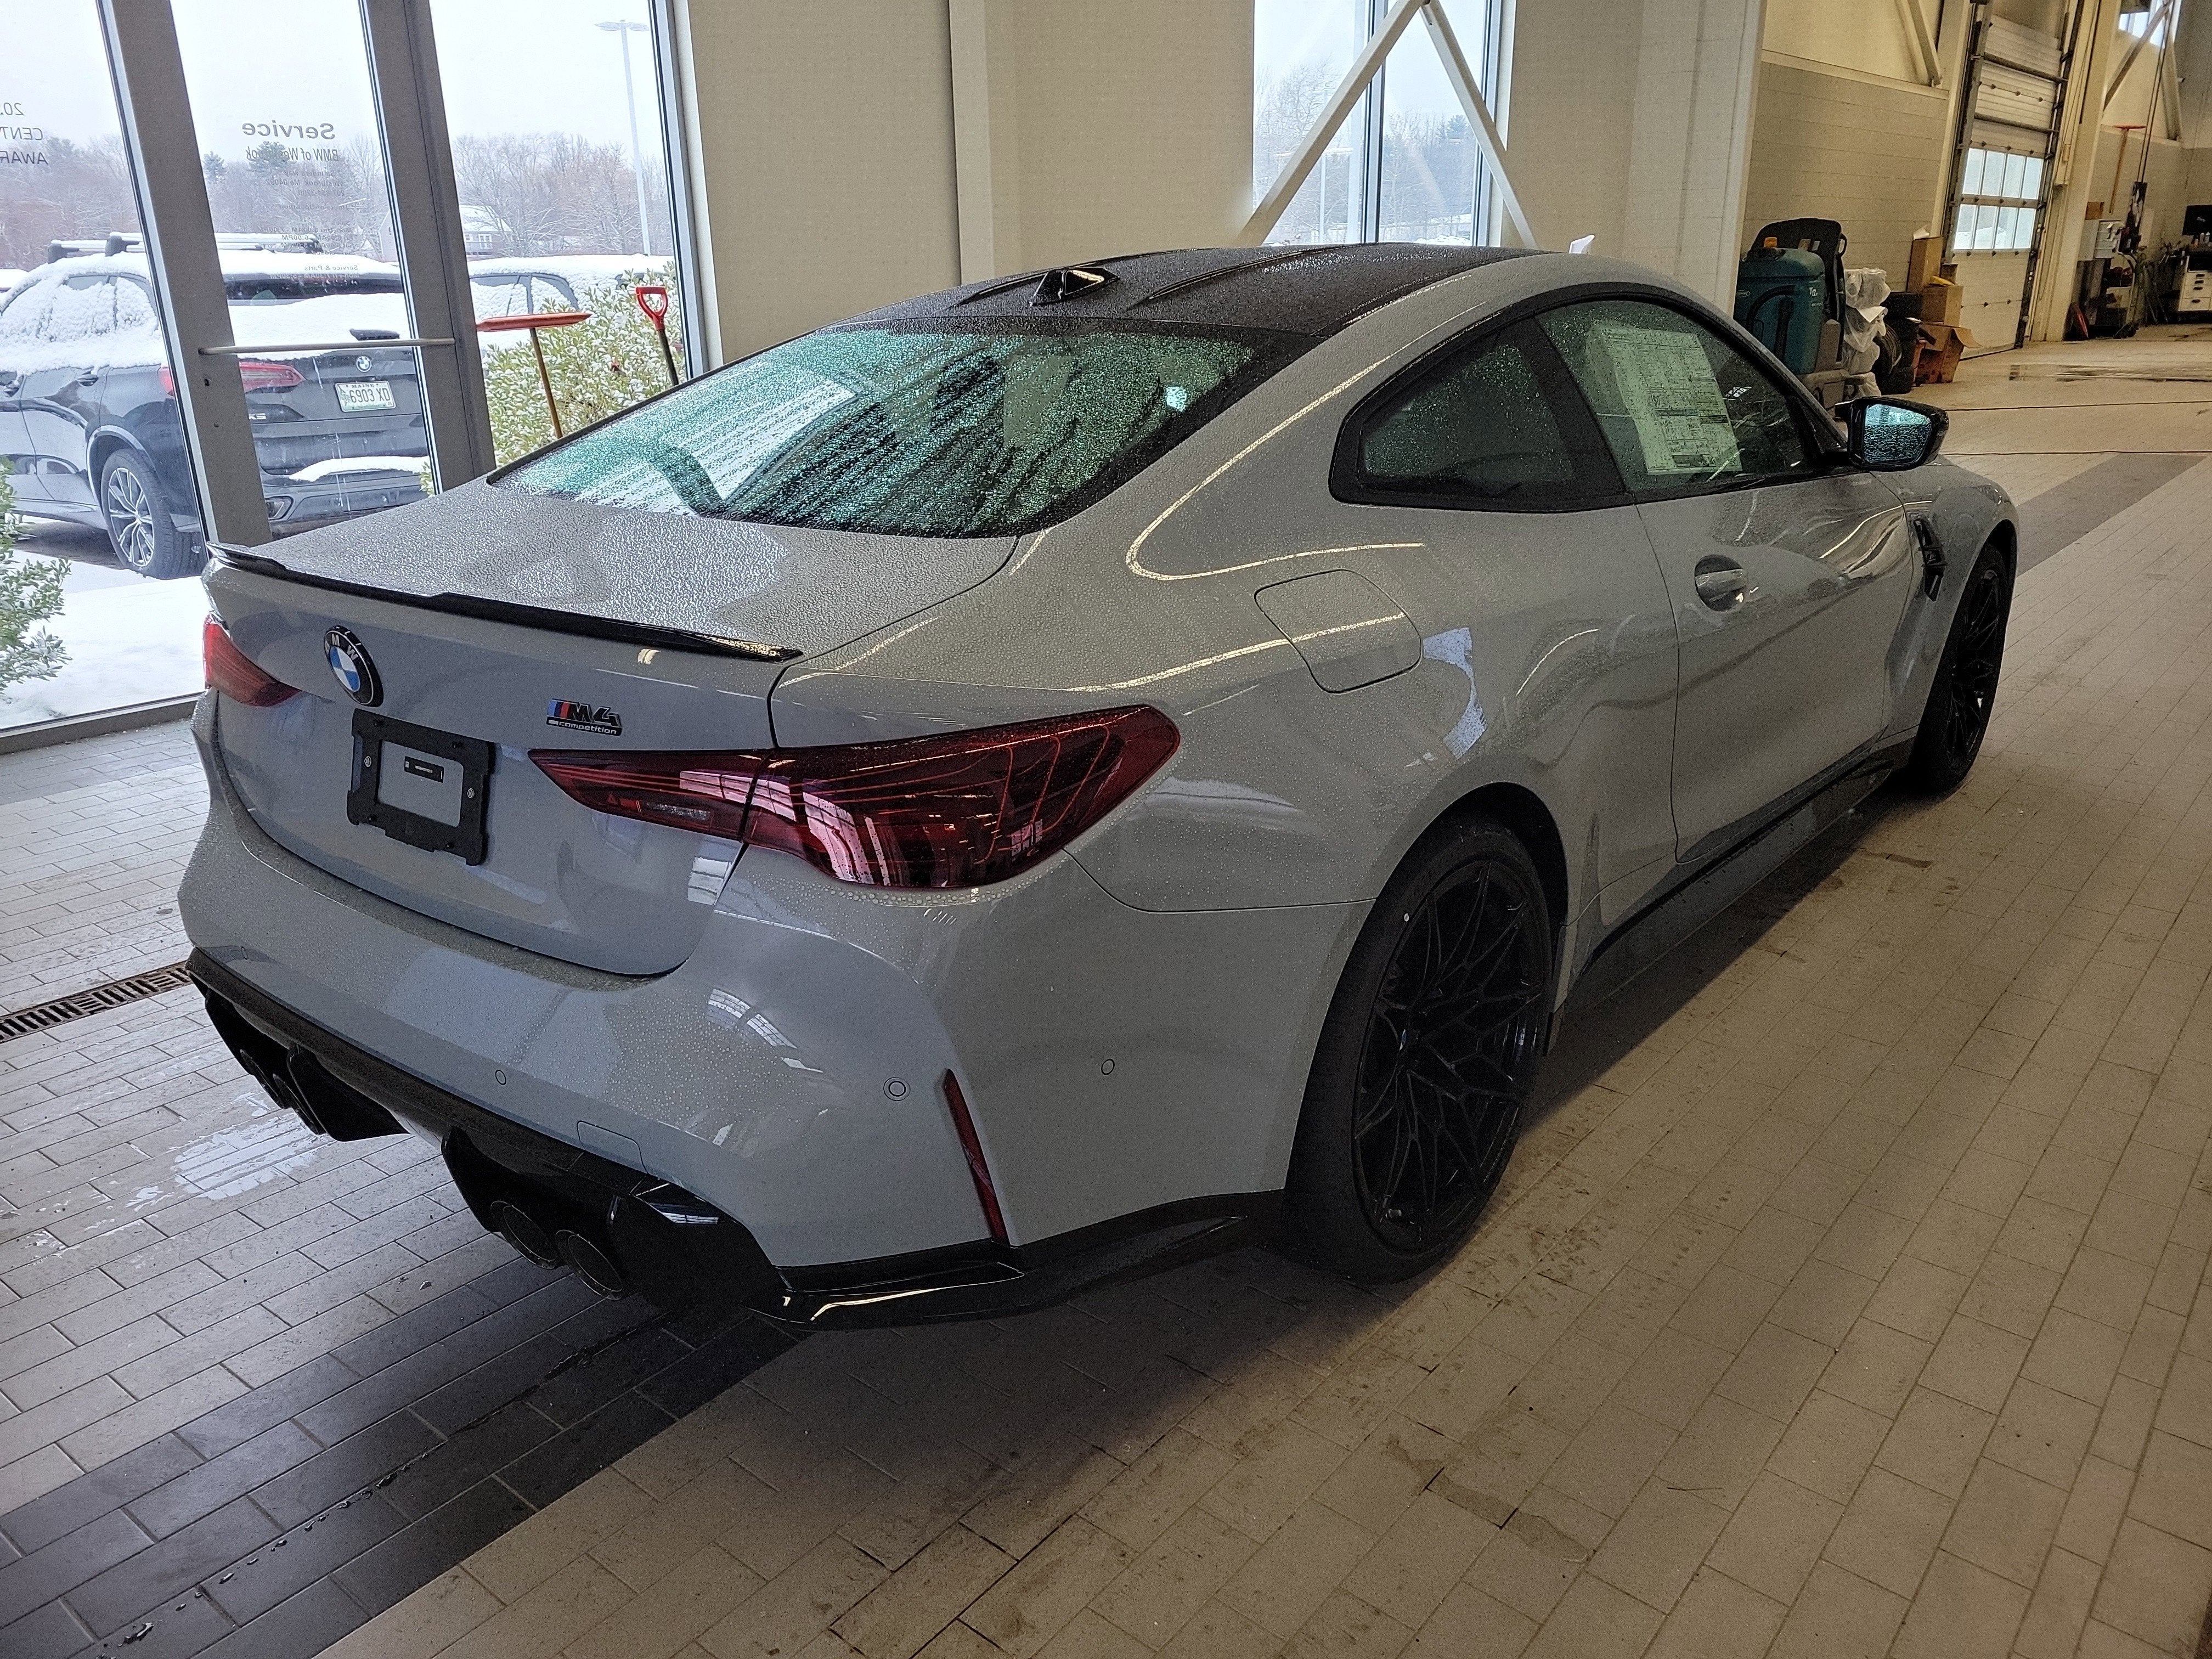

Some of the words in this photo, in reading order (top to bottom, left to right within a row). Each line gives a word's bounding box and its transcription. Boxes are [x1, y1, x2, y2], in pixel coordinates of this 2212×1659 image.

[349, 388, 375, 403] 6903
[376, 387, 391, 402] XD
[567, 702, 622, 729] M4
[559, 721, 617, 735] competition
